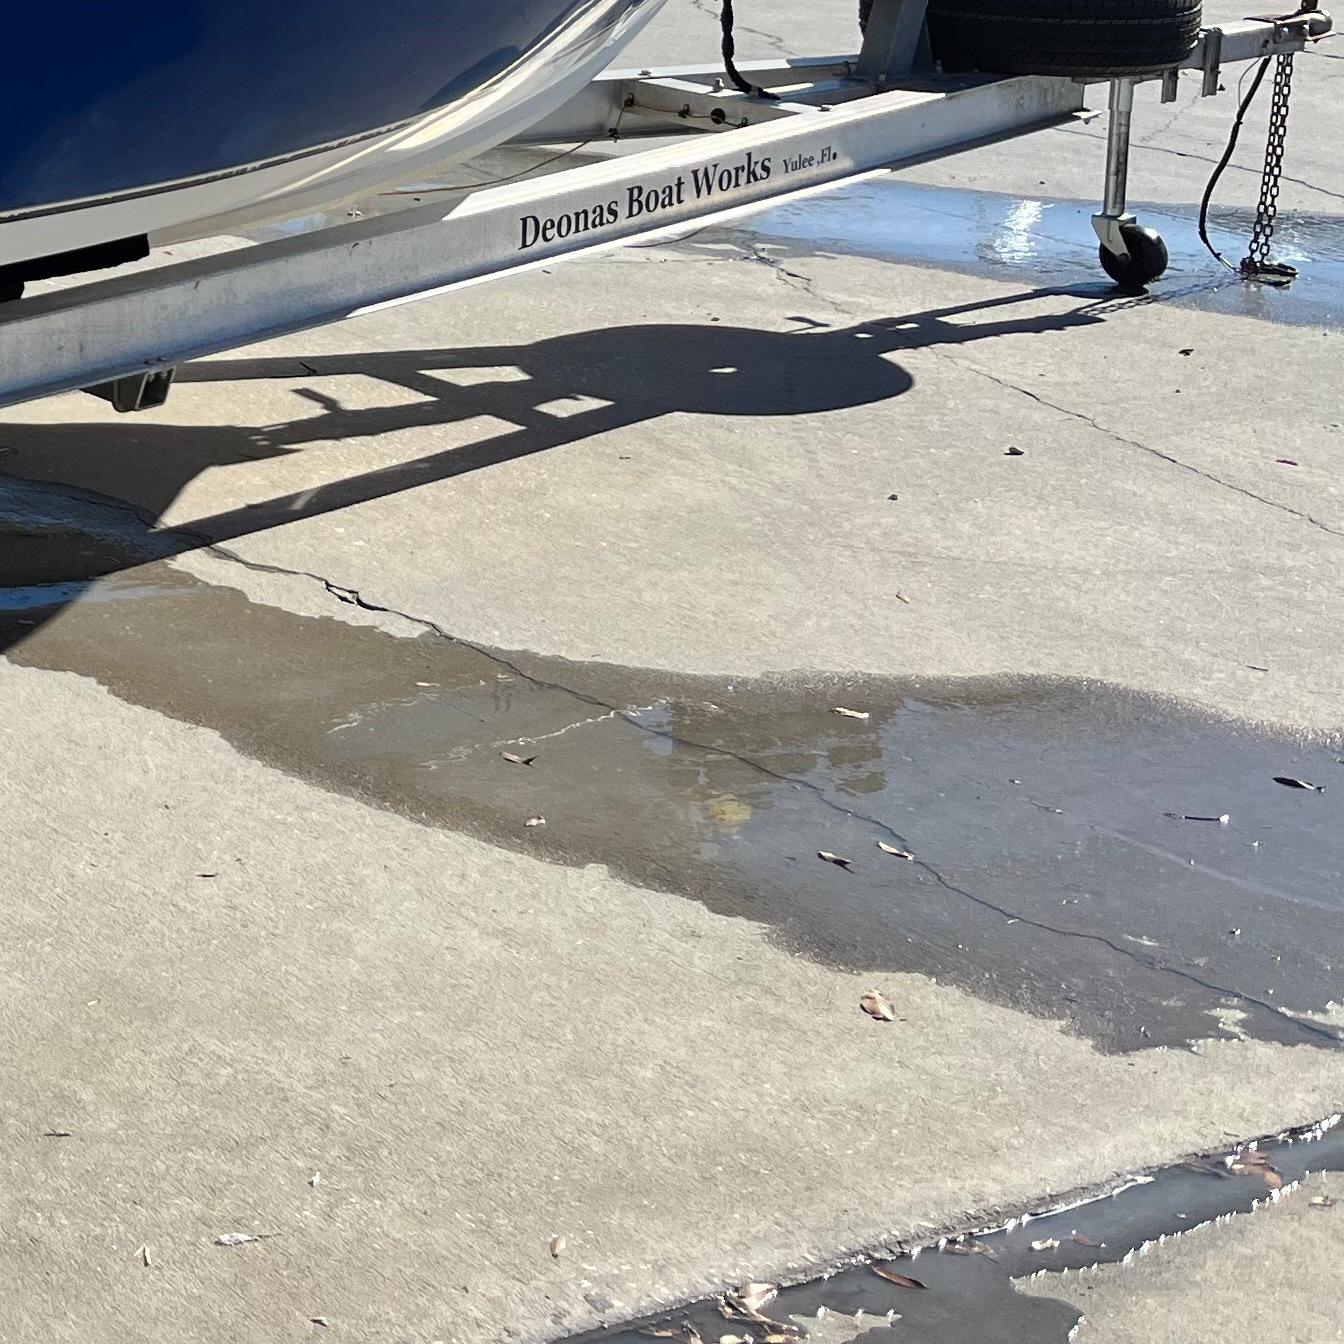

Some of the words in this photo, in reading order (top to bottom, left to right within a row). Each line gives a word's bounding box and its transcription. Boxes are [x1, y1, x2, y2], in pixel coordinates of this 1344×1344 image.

[518, 199, 619, 250] Deonas
[625, 175, 686, 219] Boat
[691, 151, 772, 199] Works
[783, 156, 815, 175] Yulee
